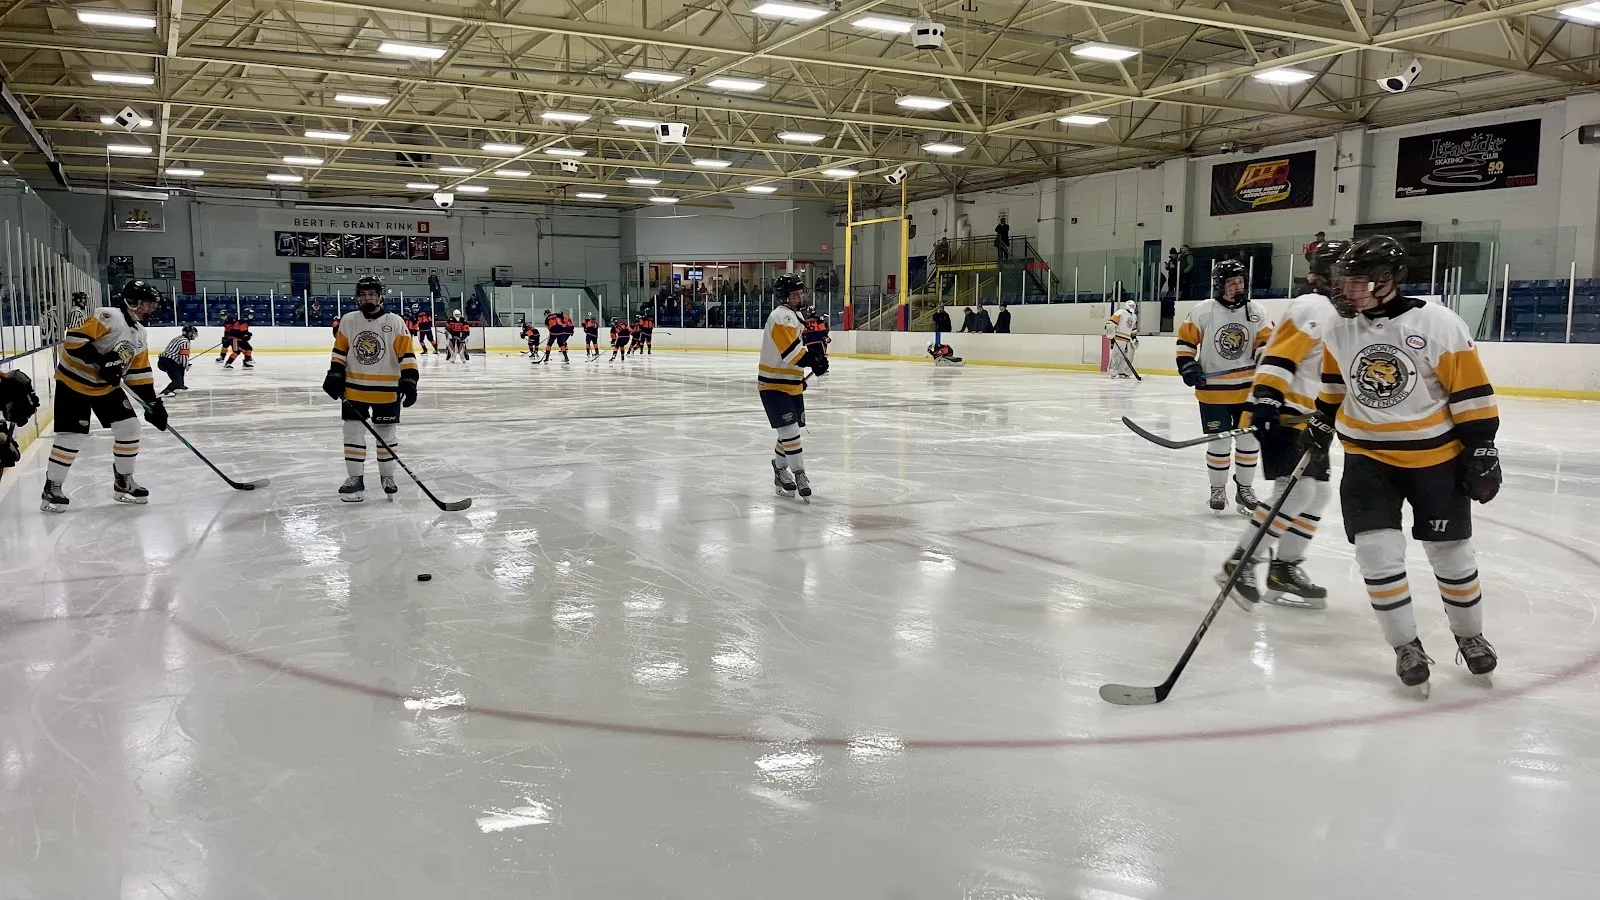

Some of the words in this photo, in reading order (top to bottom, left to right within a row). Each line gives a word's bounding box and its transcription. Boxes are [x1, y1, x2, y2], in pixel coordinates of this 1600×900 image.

[1429, 134, 1503, 160] Leaside
[1435, 156, 1464, 166] SKATING
[1481, 152, 1499, 160] CLUB
[1488, 161, 1505, 172] 50
[294, 218, 325, 228] BERT
[330, 220, 338, 228] F.
[343, 220, 381, 230] GRANT
[386, 222, 414, 231] RINK
[420, 224, 427, 232] B
[1408, 337, 1424, 347] Esso
[1362, 345, 1398, 356] TORONTO
[1357, 393, 1376, 406] EAST
[1377, 390, 1409, 407] ENDERS
